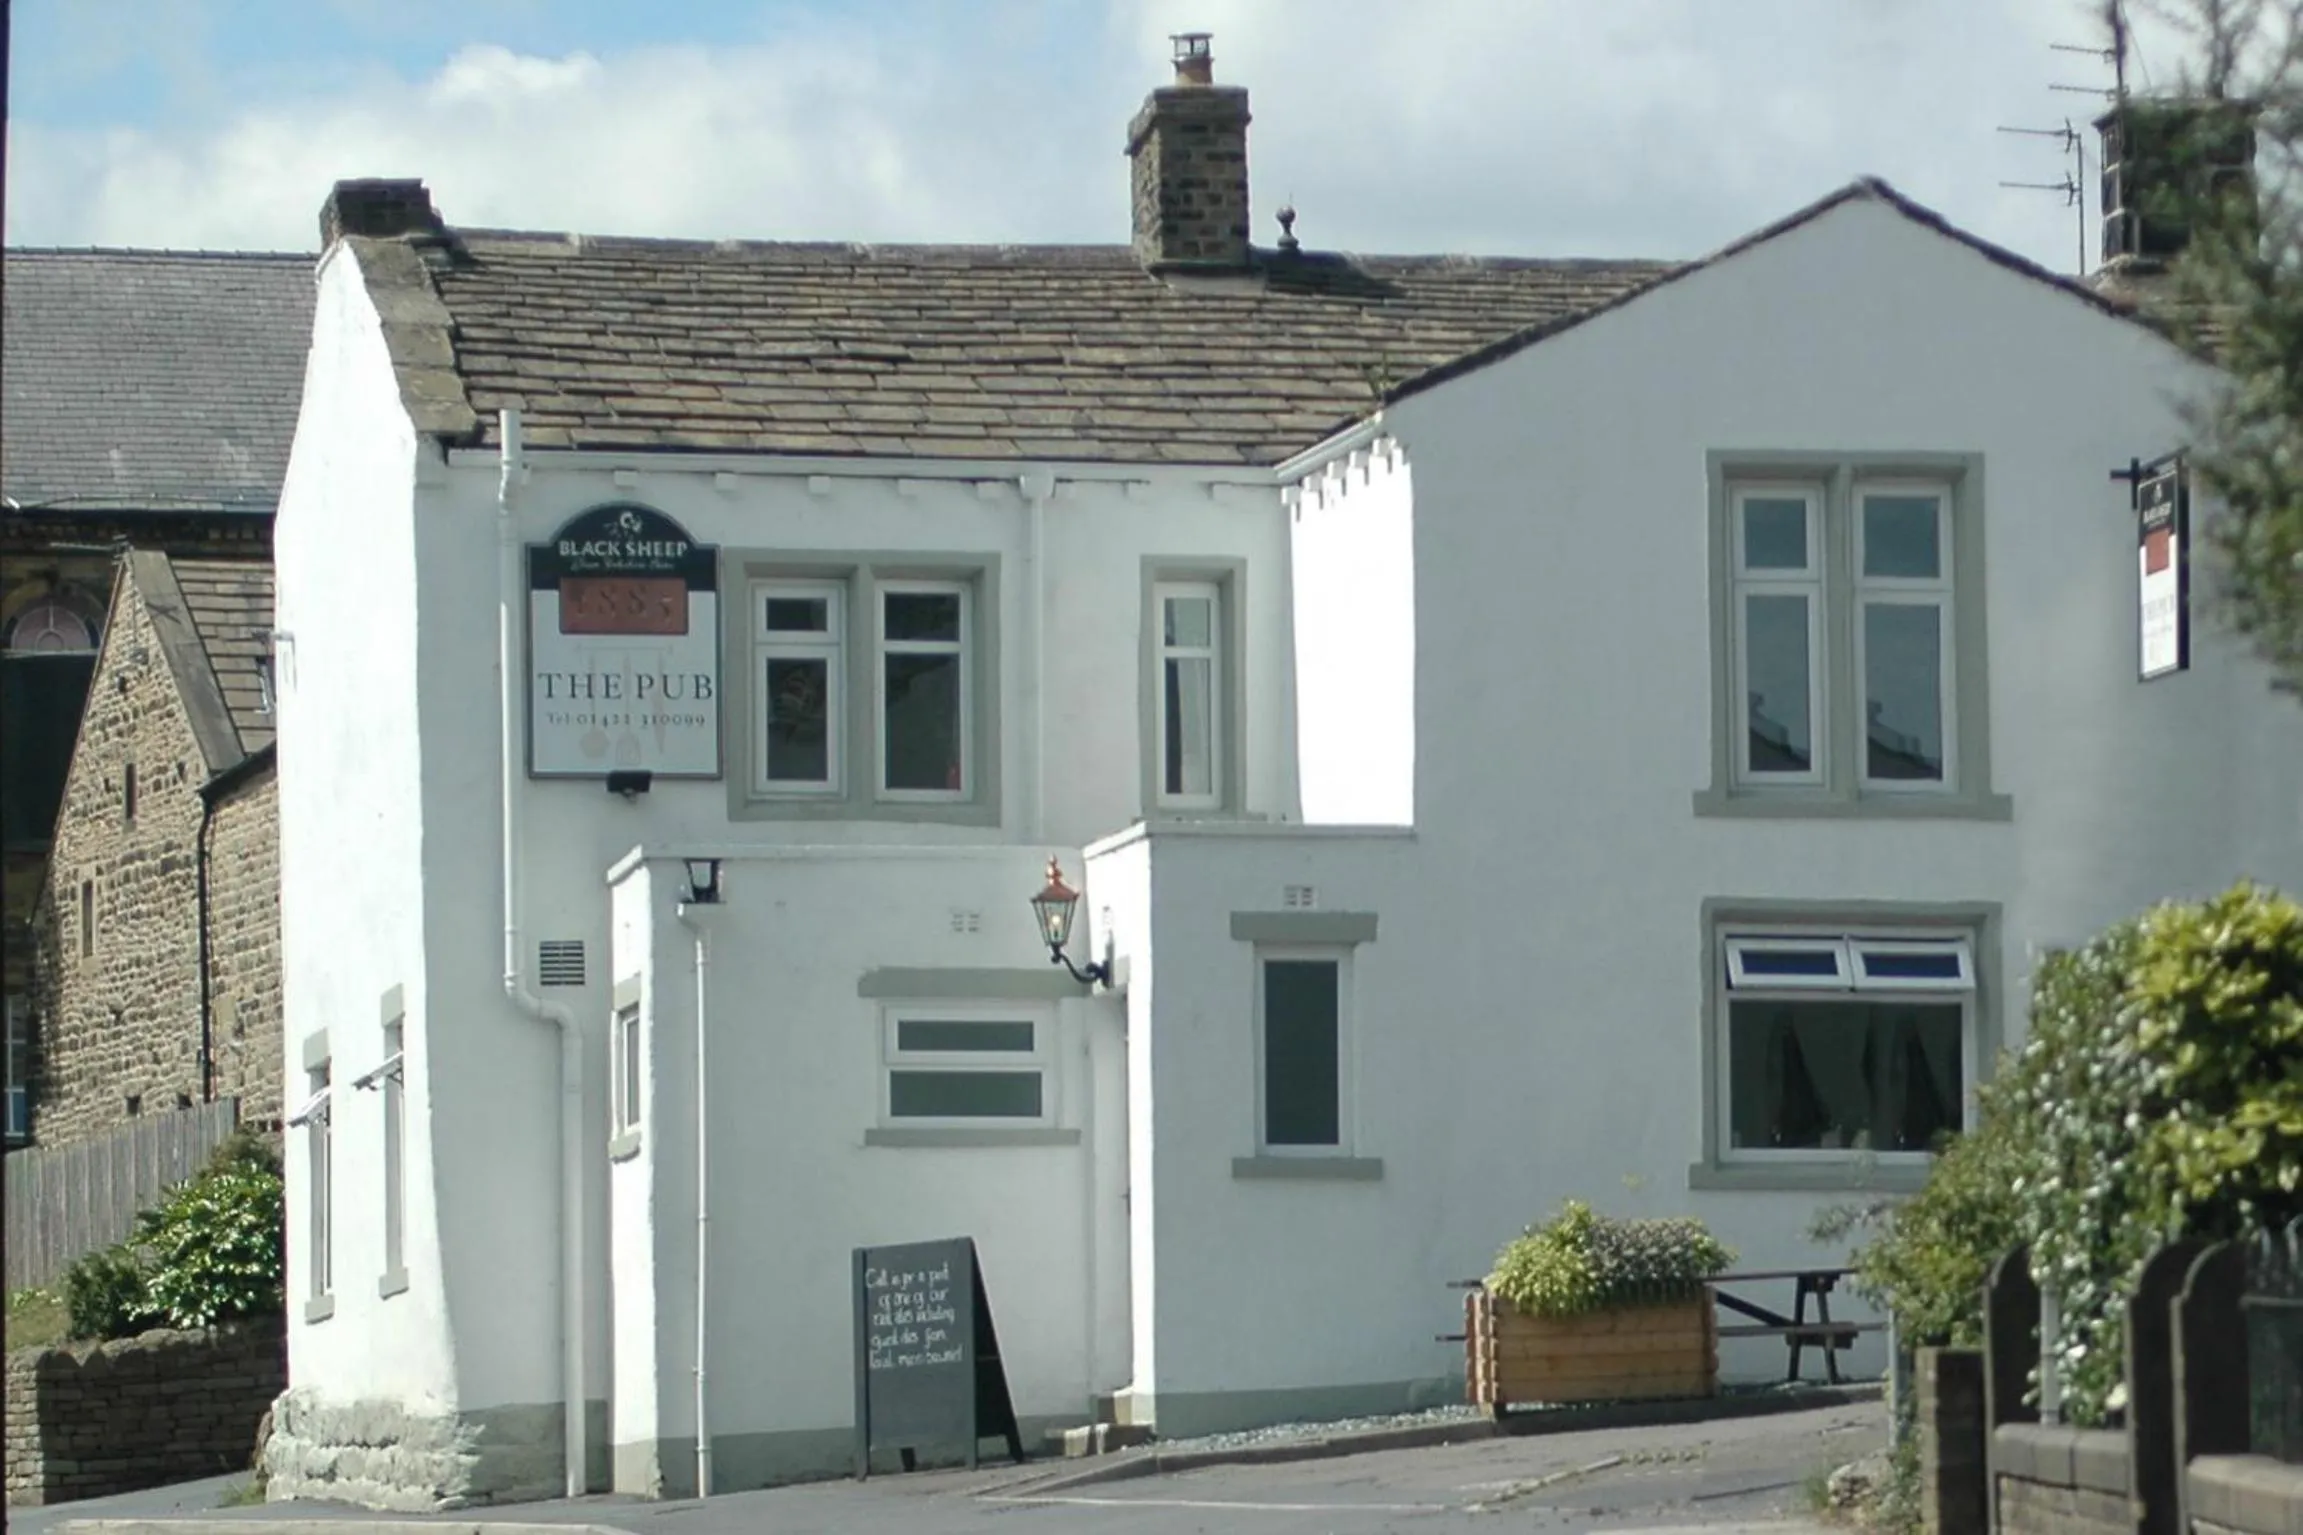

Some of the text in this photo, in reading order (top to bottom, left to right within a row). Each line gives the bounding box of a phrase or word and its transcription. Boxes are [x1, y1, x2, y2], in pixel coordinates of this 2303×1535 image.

[559, 540, 688, 557] BLACK SHEEP
[537, 673, 713, 700] THE PUB
